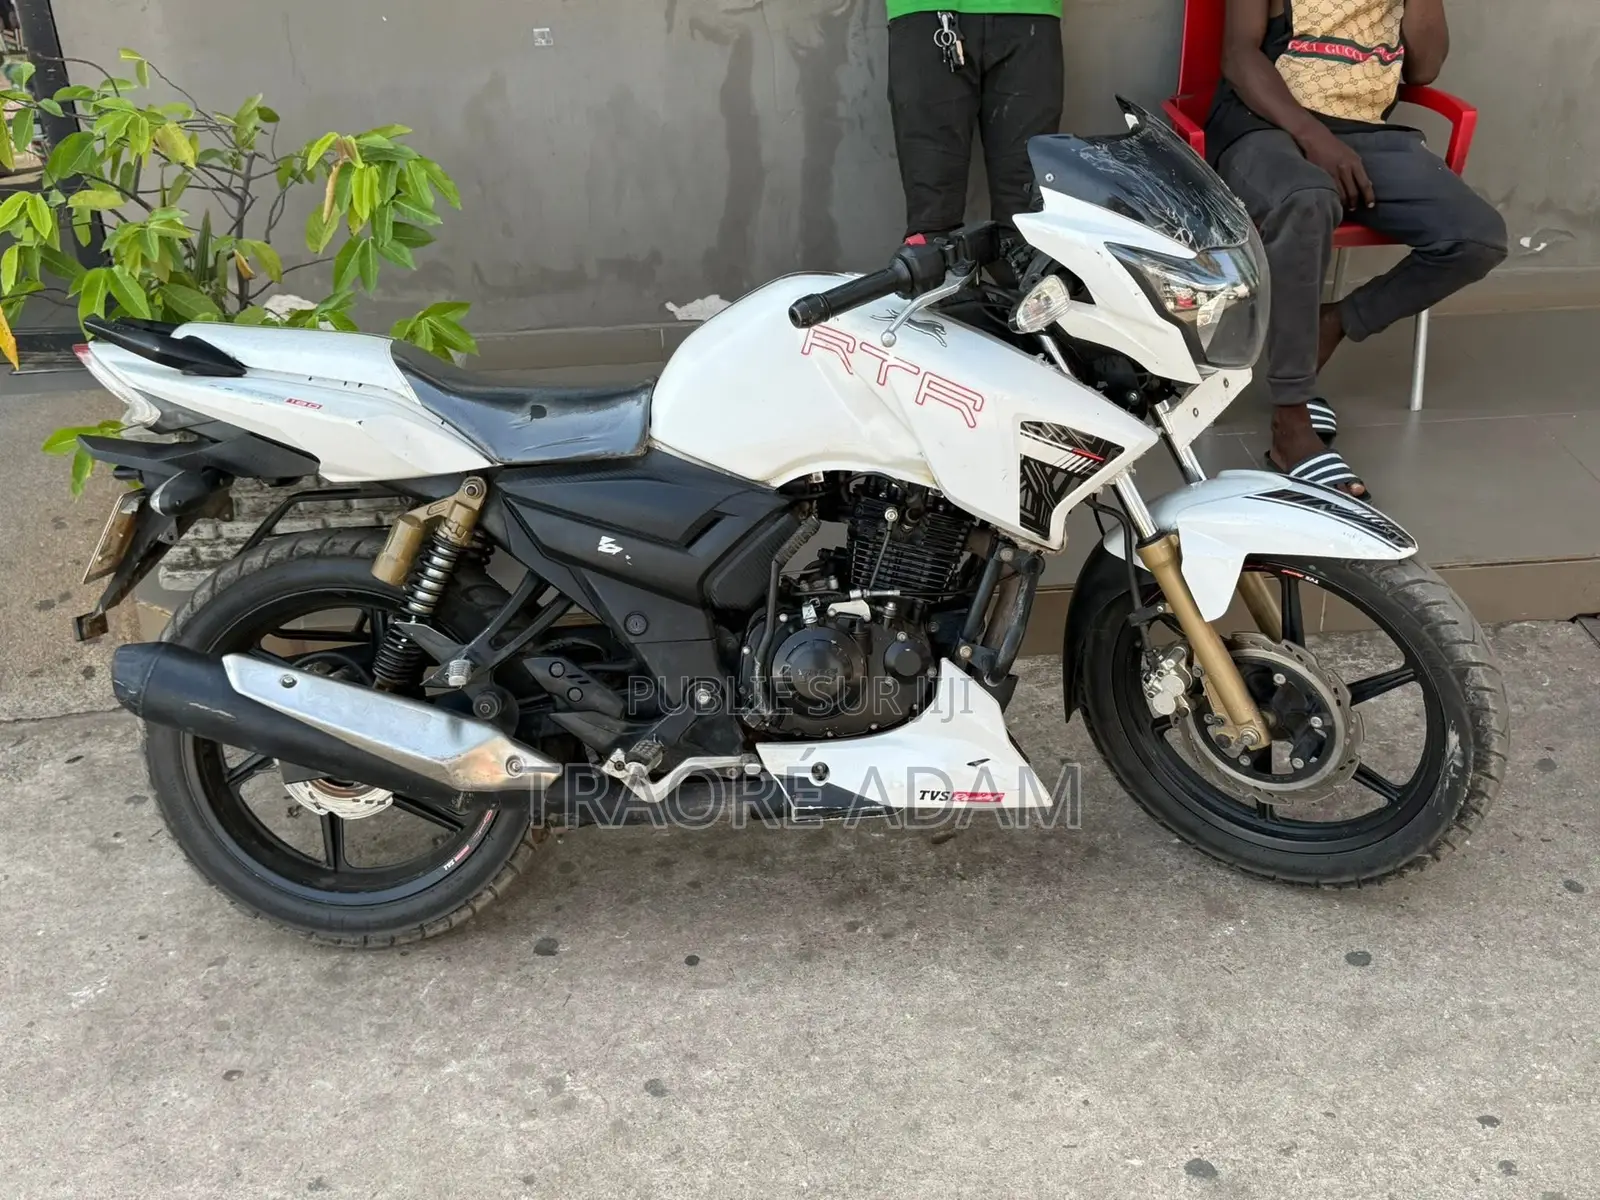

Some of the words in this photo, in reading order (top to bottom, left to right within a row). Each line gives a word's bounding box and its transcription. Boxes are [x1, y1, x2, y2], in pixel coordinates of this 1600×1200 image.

[1324, 43, 1364, 61] GUCCI
[801, 324, 985, 429] RTR
[919, 790, 950, 802] TVS
